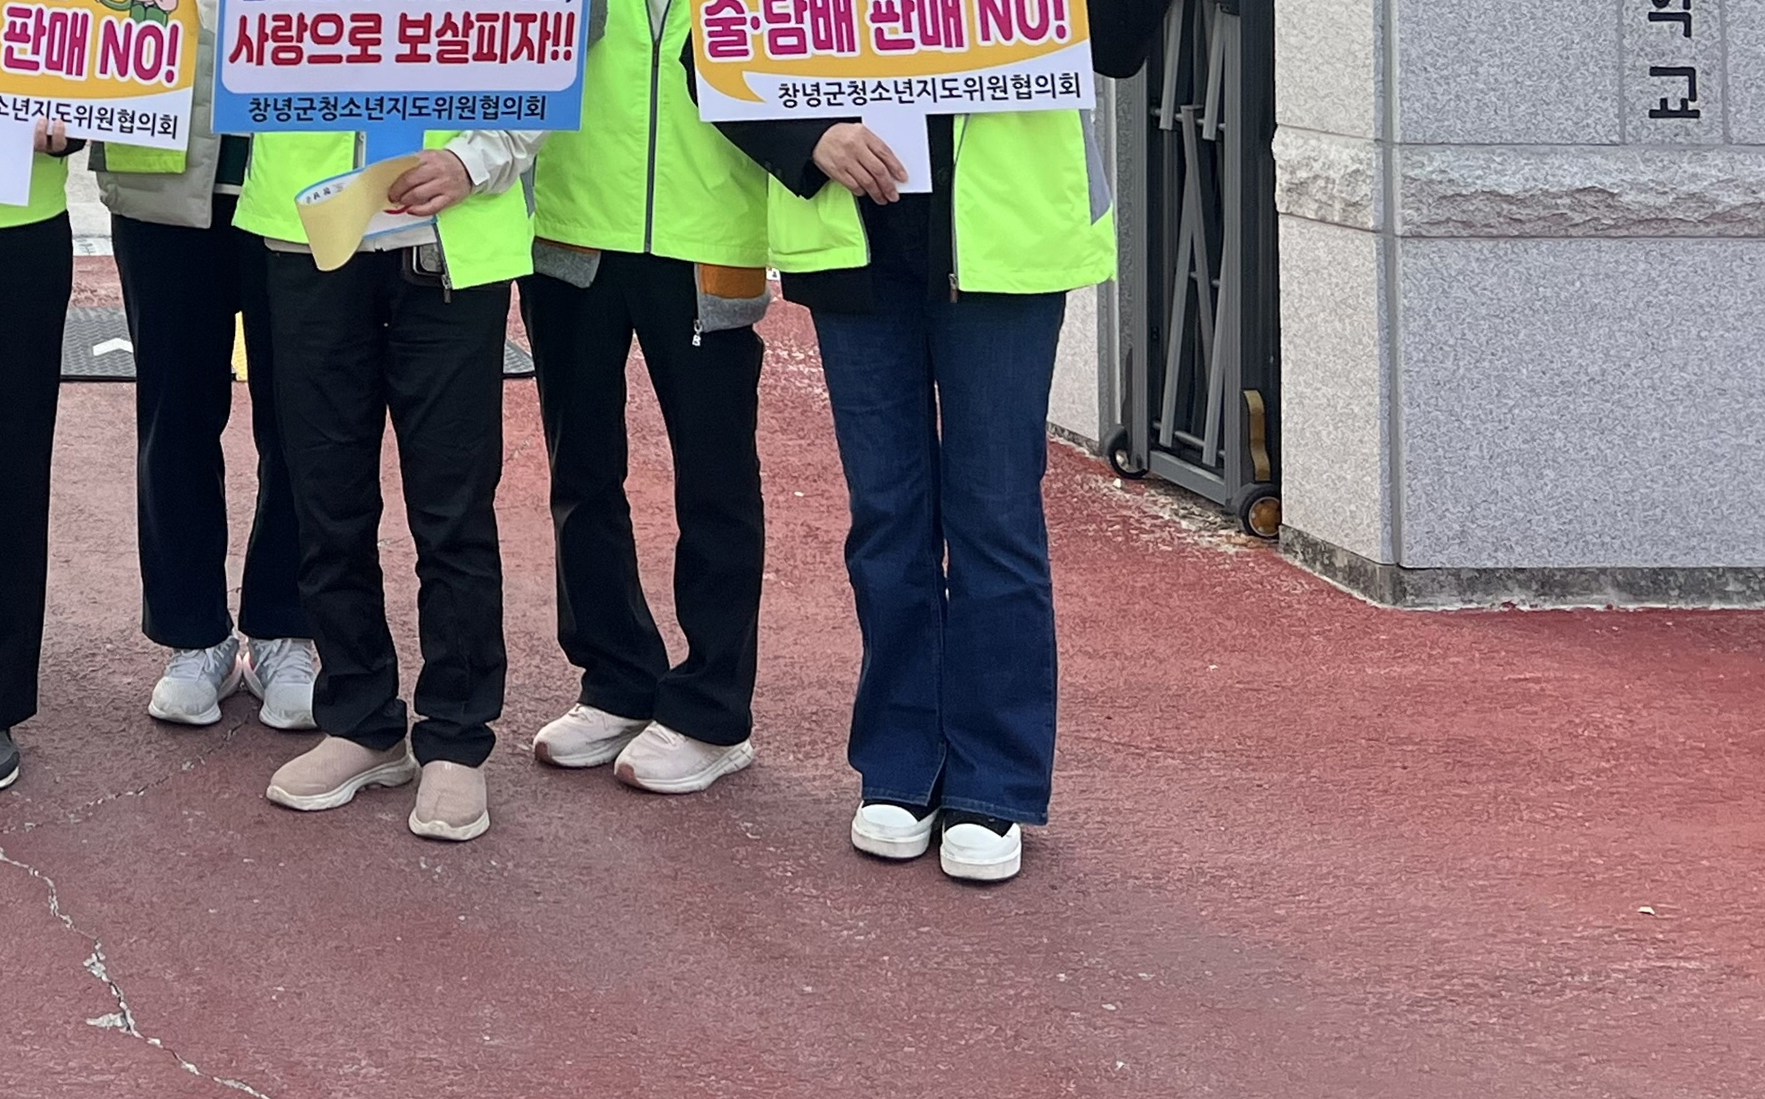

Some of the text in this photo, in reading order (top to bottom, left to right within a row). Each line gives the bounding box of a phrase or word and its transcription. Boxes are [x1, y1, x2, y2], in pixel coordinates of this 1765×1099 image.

[3, 6, 89, 77] 판매
[99, 19, 180, 83] NO!
[228, 11, 575, 66] 사랑으로 보살피자!!
[248, 95, 547, 123] 창녕군청소년지도위원협의회
[778, 72, 1082, 109] 창녕군청소년지도위원협의회
